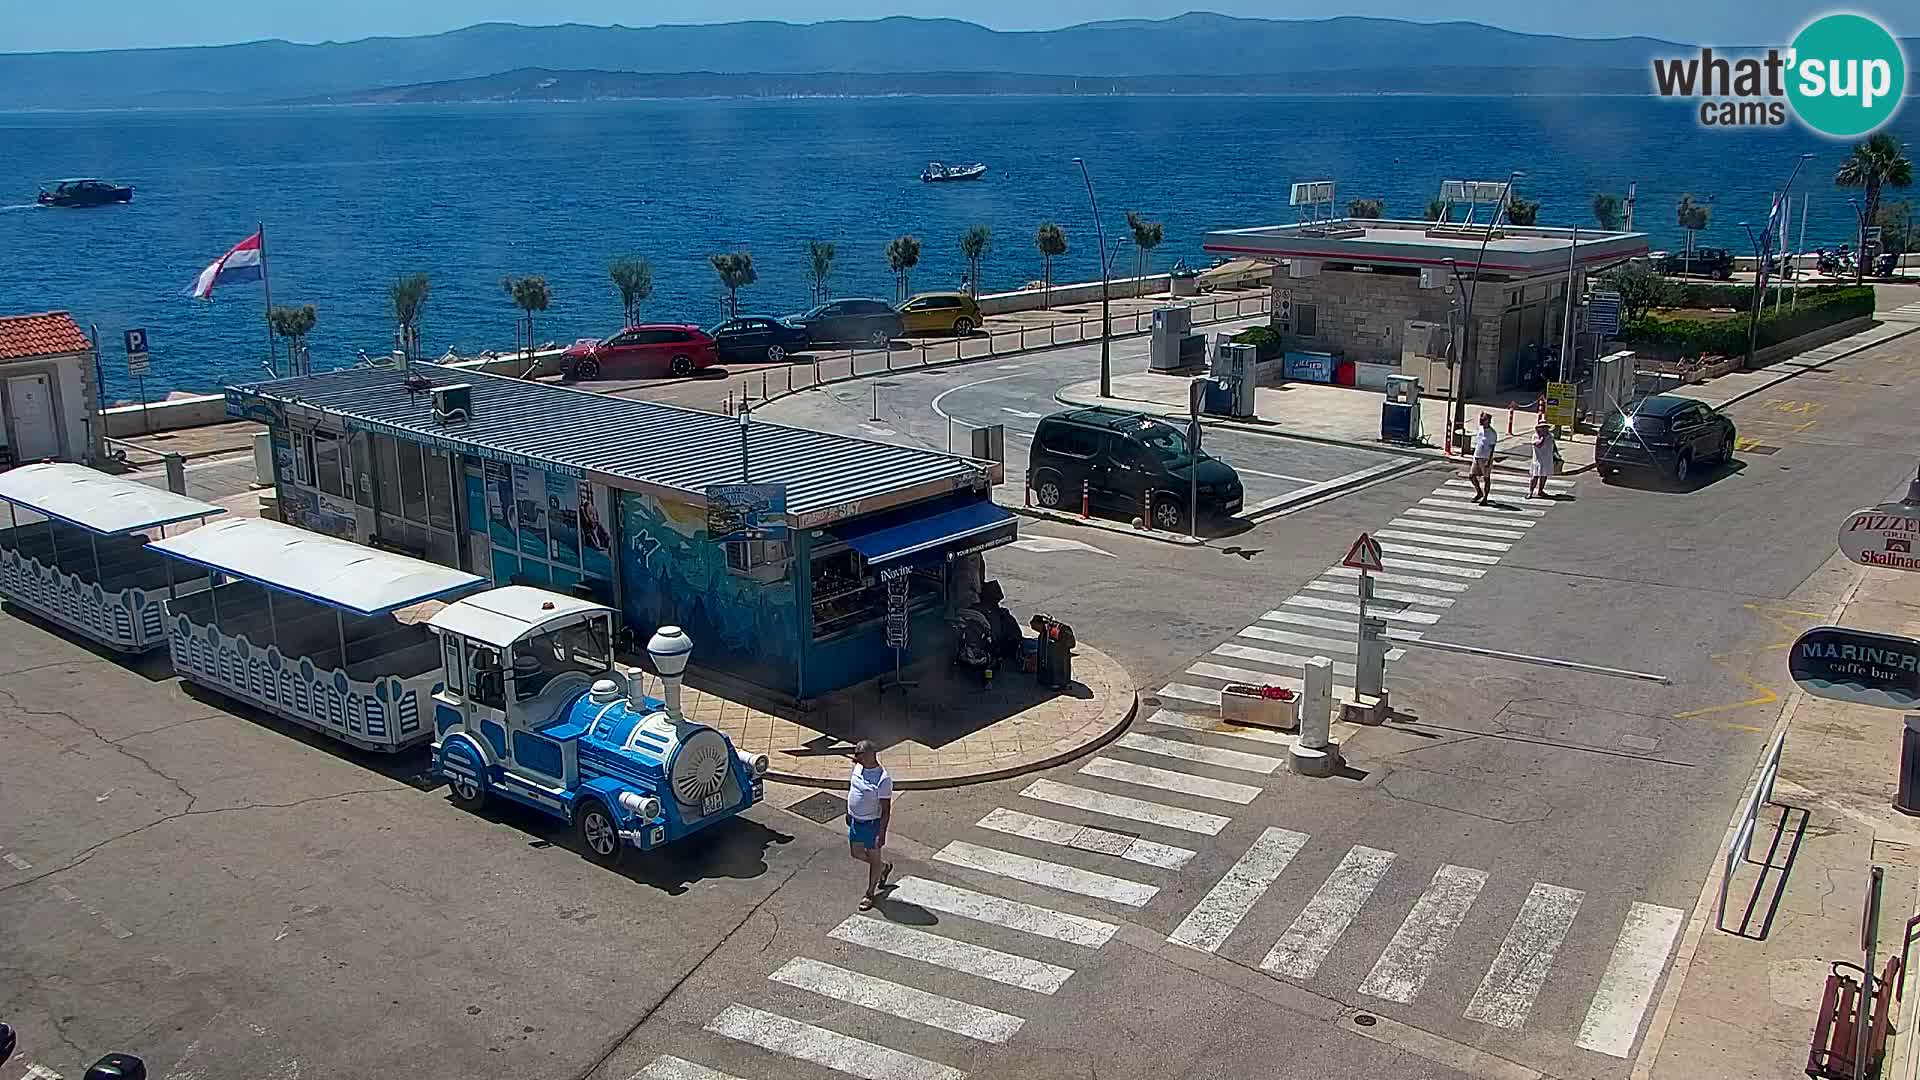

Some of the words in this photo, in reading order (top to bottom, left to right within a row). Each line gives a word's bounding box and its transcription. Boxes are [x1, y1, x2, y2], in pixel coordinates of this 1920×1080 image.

[130, 332, 142, 350] P
[478, 447, 493, 459] BUS
[494, 450, 526, 465] STATION
[528, 457, 554, 471] TICKET
[556, 464, 582, 478] OFFICE
[1848, 516, 1920, 533] PIZZE
[1882, 530, 1918, 541] GRILL
[1802, 643, 1920, 673] MARINER
[1871, 666, 1897, 680] bar
